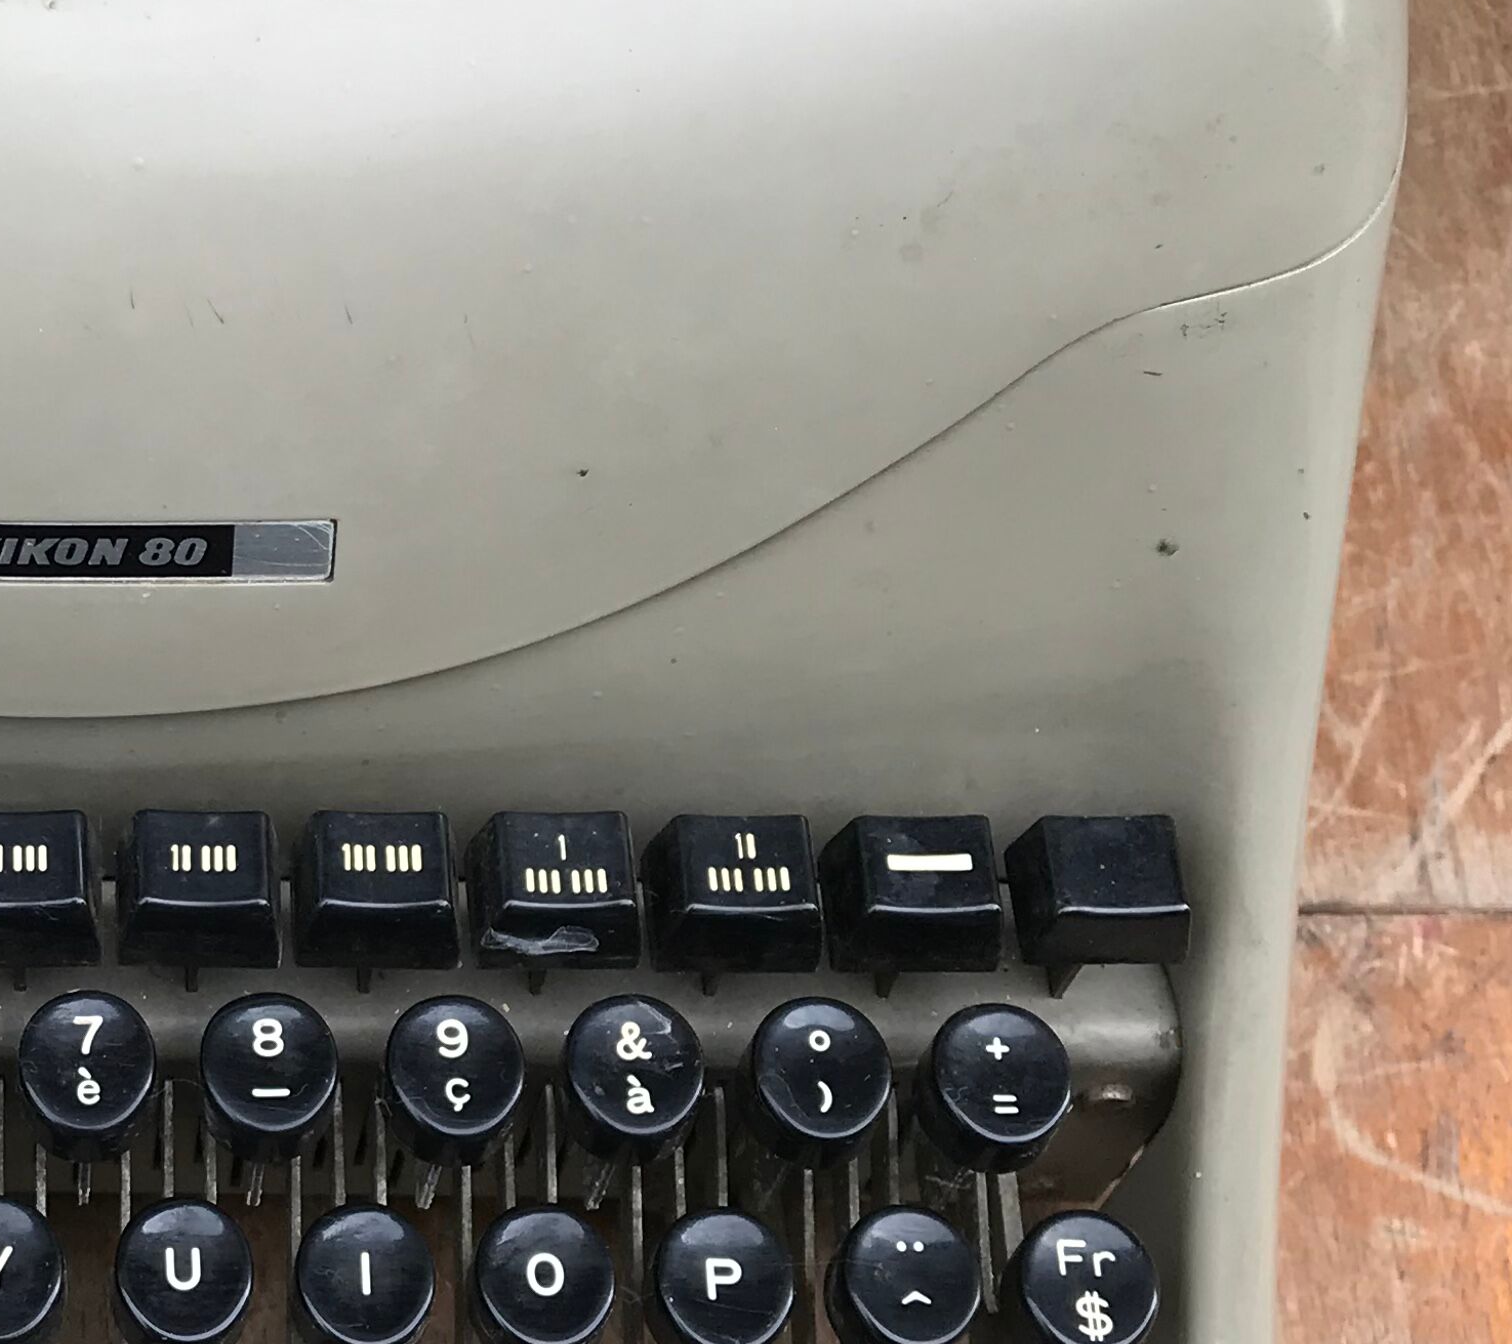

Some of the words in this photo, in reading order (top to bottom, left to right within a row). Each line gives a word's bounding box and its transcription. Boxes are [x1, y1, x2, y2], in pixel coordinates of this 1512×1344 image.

[139, 537, 208, 566] 80
[72, 1014, 104, 1055] 7
[252, 1017, 285, 1057] 8
[435, 1017, 469, 1059] 9
[616, 1020, 653, 1061] &
[985, 1036, 1010, 1060] +
[76, 1066, 101, 1105] è
[445, 1077, 471, 1112] ç
[626, 1074, 655, 1115] à
[992, 1094, 1019, 1114] =
[165, 1247, 202, 1291] U
[360, 1251, 372, 1296] I
[526, 1252, 565, 1297] O
[1055, 1238, 1117, 1278] Fr
[705, 1257, 742, 1301] P
[1075, 1290, 1114, 1342] $
